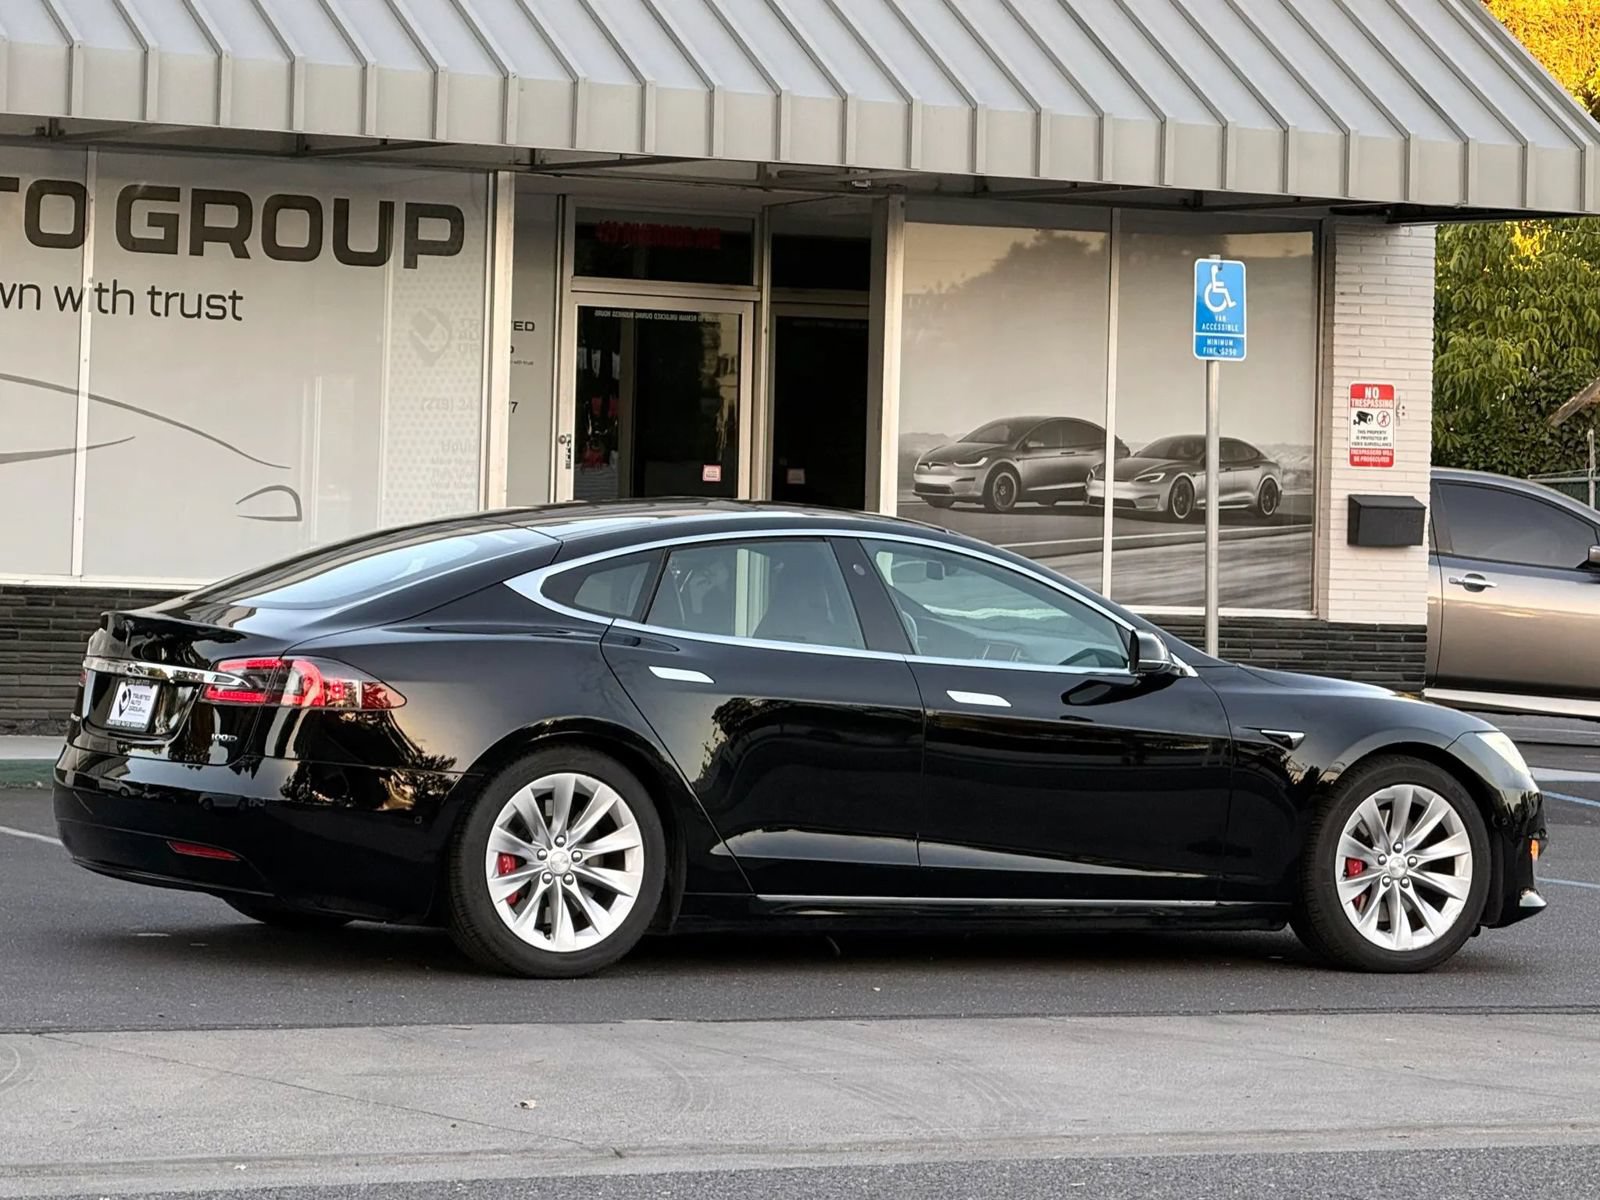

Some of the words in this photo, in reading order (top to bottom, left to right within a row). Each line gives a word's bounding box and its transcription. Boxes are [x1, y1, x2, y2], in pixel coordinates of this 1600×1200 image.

[0, 176, 90, 249] O
[115, 184, 465, 269] GROUP
[54, 279, 134, 315] wth
[147, 285, 243, 321] trust
[1202, 323, 1239, 332] ACCESSIBLE
[1207, 338, 1233, 346] MINIMUM
[1364, 386, 1380, 399] NO
[1350, 398, 1394, 409] TRESPASSING
